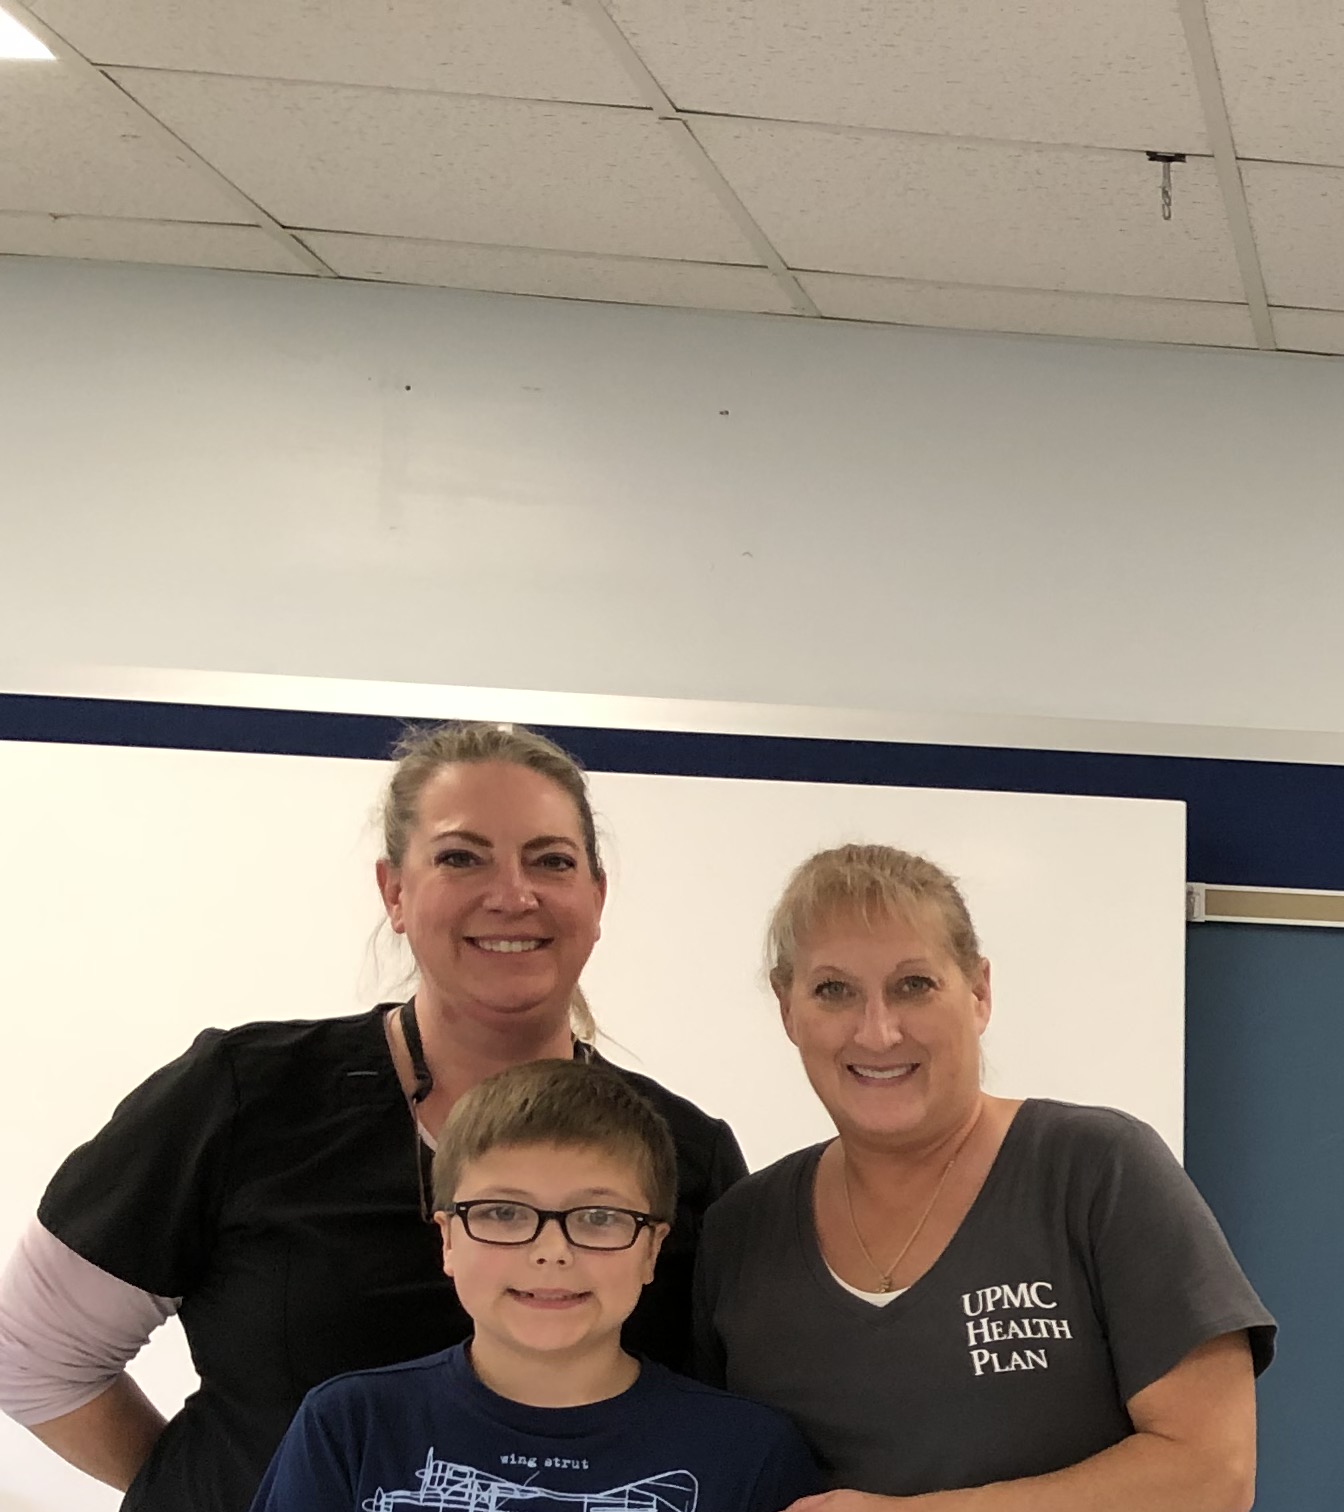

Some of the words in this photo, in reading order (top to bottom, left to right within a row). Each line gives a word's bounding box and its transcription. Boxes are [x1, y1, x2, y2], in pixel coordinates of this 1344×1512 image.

[961, 1281, 1058, 1317] UPMC
[966, 1317, 1074, 1347] HEALTH
[969, 1349, 1049, 1376] PLAN
[500, 1453, 538, 1468] wing
[544, 1455, 590, 1470] strut
